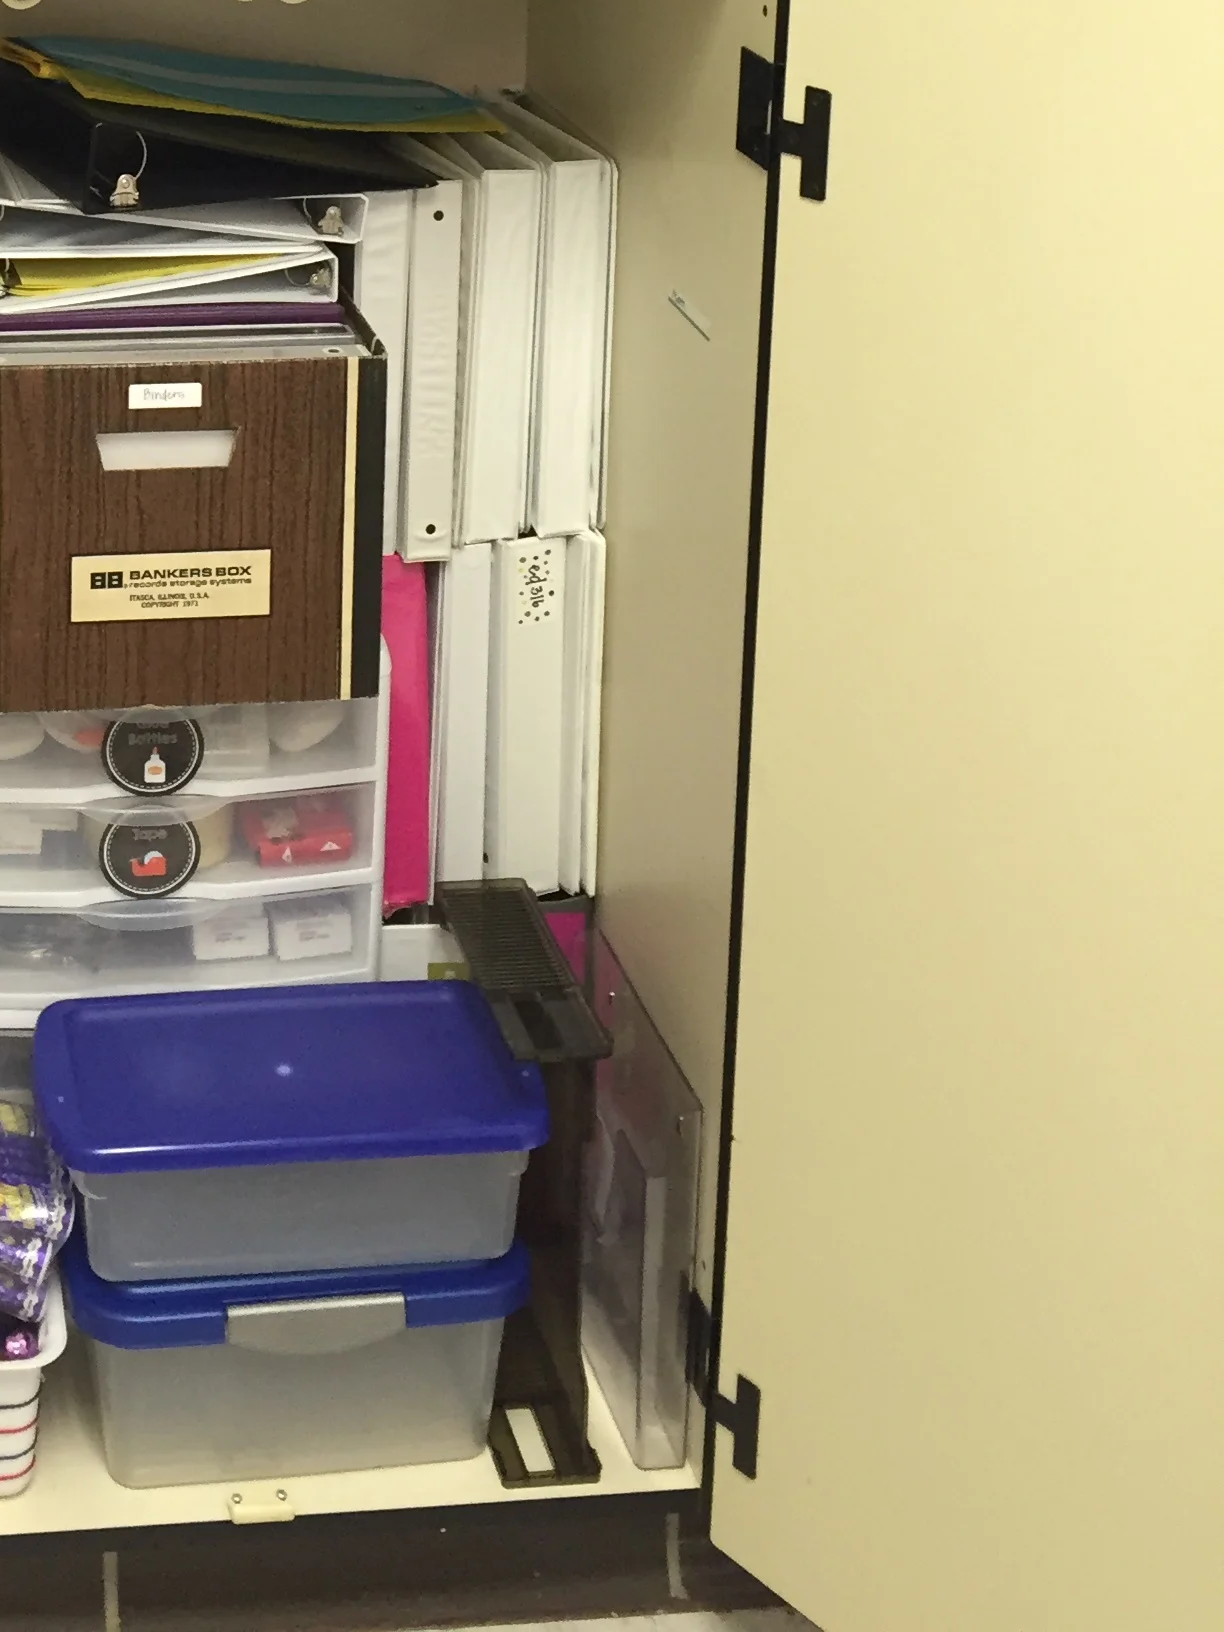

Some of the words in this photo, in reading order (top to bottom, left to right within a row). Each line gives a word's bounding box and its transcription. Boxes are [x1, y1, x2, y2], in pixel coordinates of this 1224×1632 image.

[142, 387, 186, 402] Binders
[129, 566, 213, 580] BANKERS
[215, 565, 252, 577] BOX
[129, 579, 168, 589] records
[169, 578, 207, 588] storage
[209, 577, 252, 587] systems
[132, 828, 169, 843] Tape
